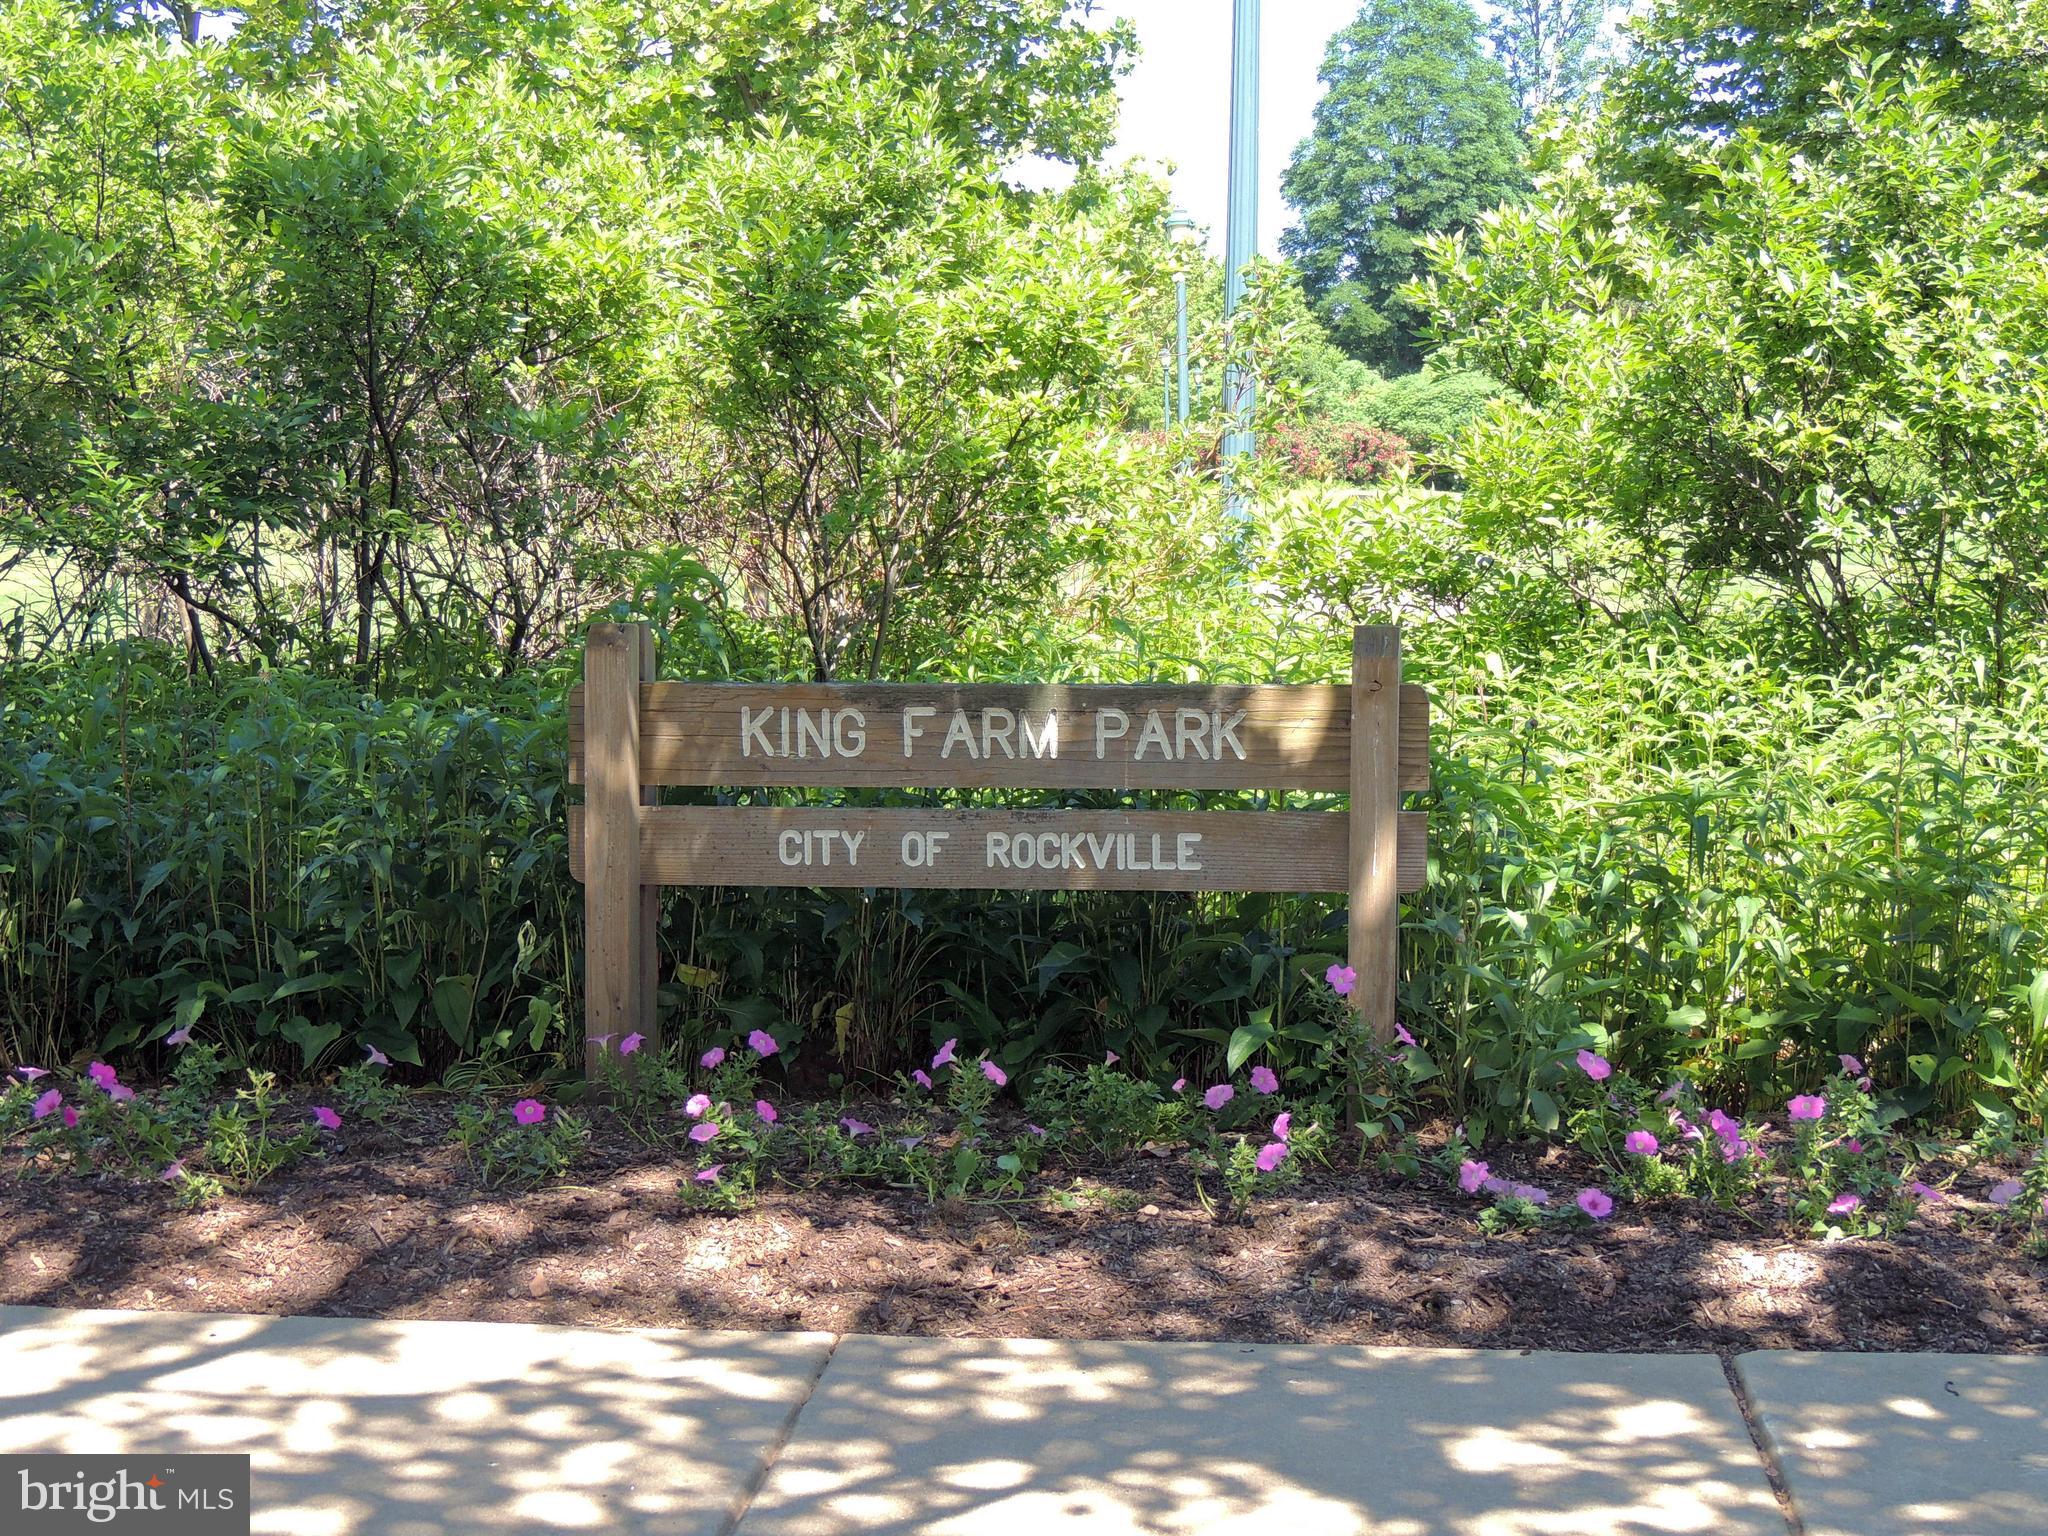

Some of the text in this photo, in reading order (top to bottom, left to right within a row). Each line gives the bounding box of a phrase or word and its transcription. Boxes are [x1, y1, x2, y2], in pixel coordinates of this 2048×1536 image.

[741, 706, 1248, 761] KING FARM PARK
[778, 829, 1202, 871] CITY OF ROCKVILLE
